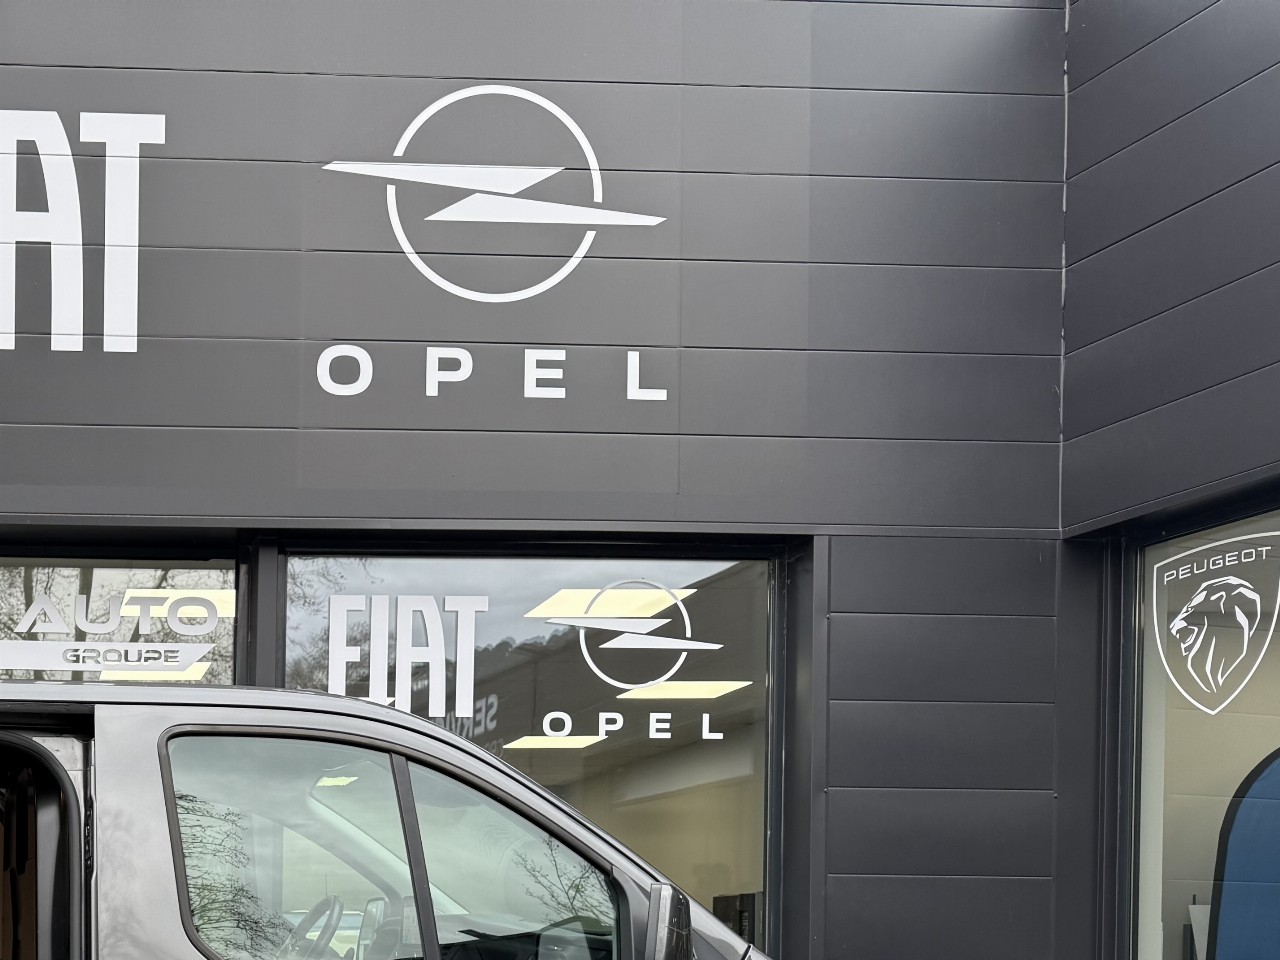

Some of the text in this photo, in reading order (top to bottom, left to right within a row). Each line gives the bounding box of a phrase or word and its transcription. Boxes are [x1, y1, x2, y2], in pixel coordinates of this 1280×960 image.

[317, 344, 668, 401] OPEL
[1164, 545, 1272, 585] PEUGEOT
[13, 593, 220, 636] AUTO
[62, 648, 180, 665] GROUPE
[328, 594, 489, 718] FIAT
[542, 711, 724, 740] OPEL
